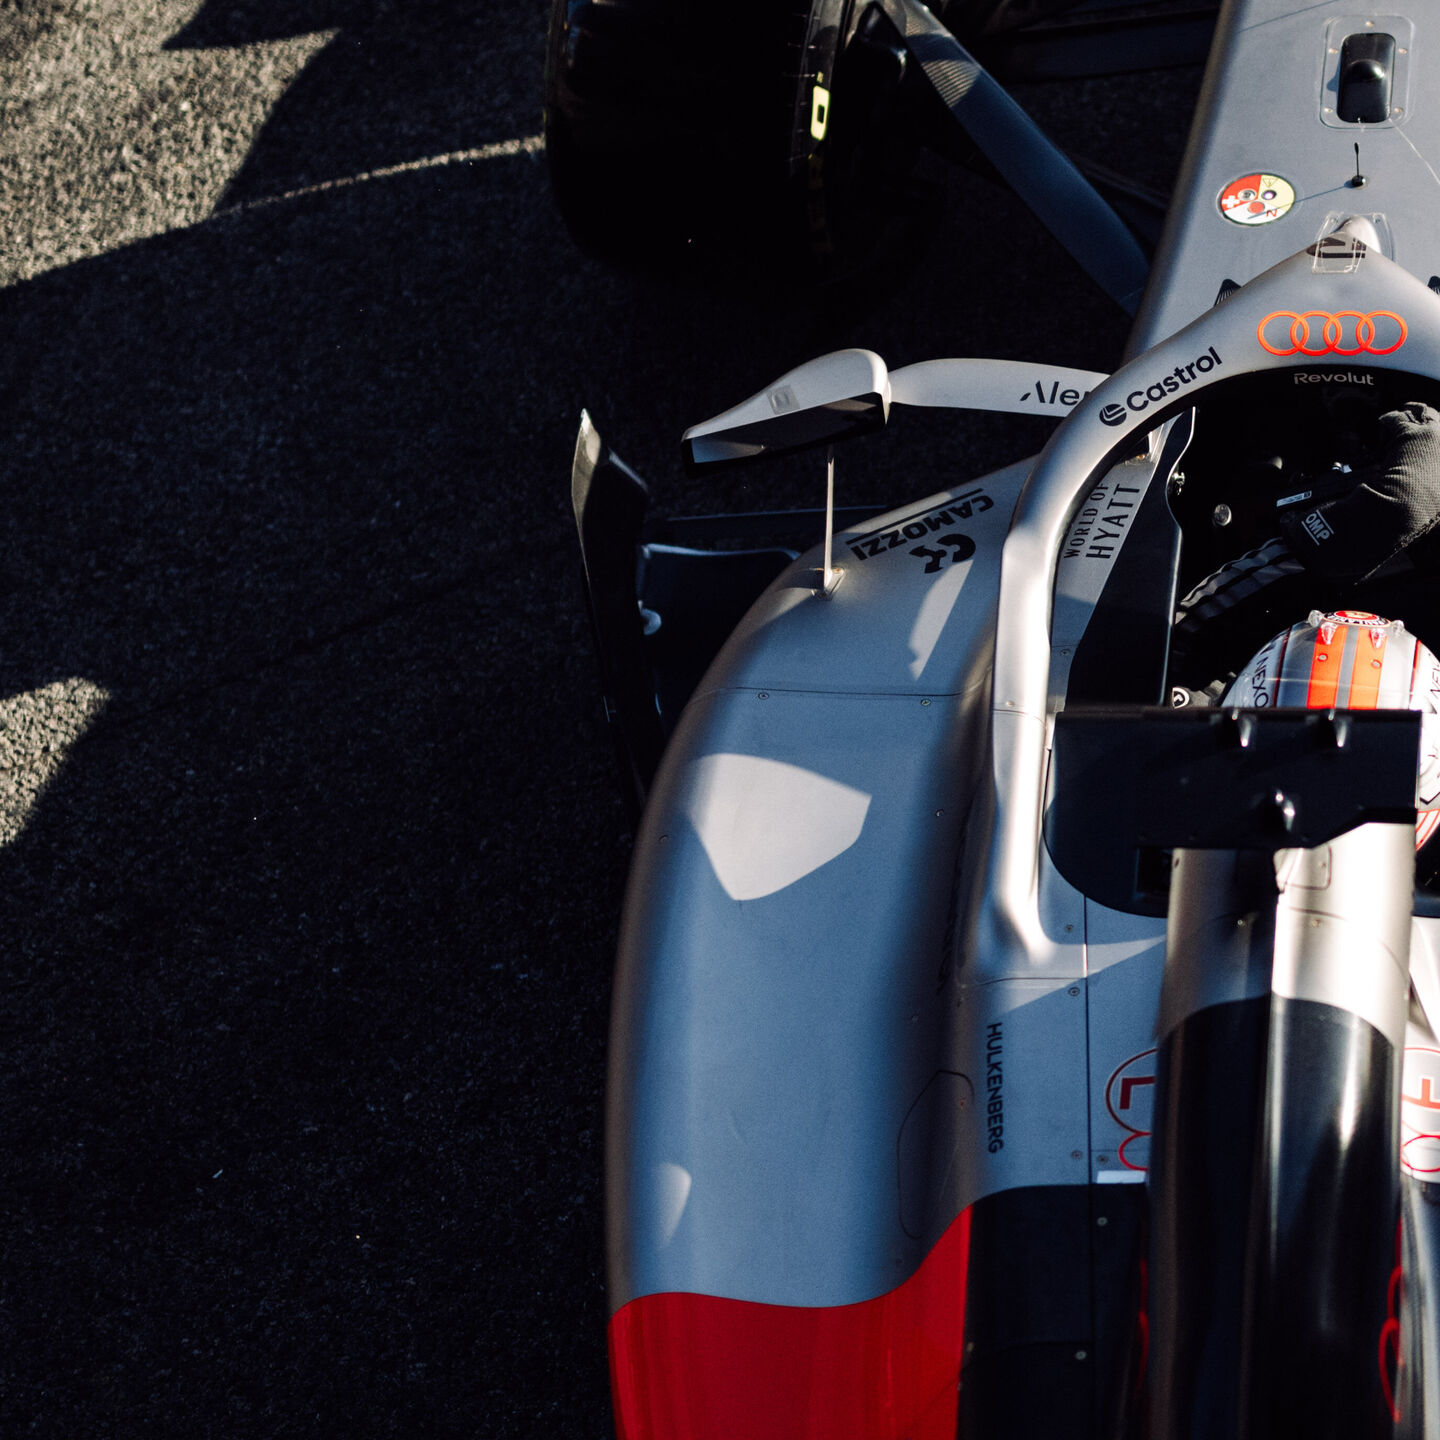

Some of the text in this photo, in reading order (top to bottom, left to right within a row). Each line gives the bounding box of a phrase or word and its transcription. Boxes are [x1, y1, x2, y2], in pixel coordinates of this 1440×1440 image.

[1126, 346, 1223, 411] Castrol
[1293, 372, 1375, 385] Revolut
[850, 494, 995, 561] CAMOZZI
[1063, 508, 1098, 559] WORLD
[1085, 483, 1140, 559] HYATT
[1305, 513, 1330, 540] OMP
[986, 1022, 1004, 1154] HULKENBERG
